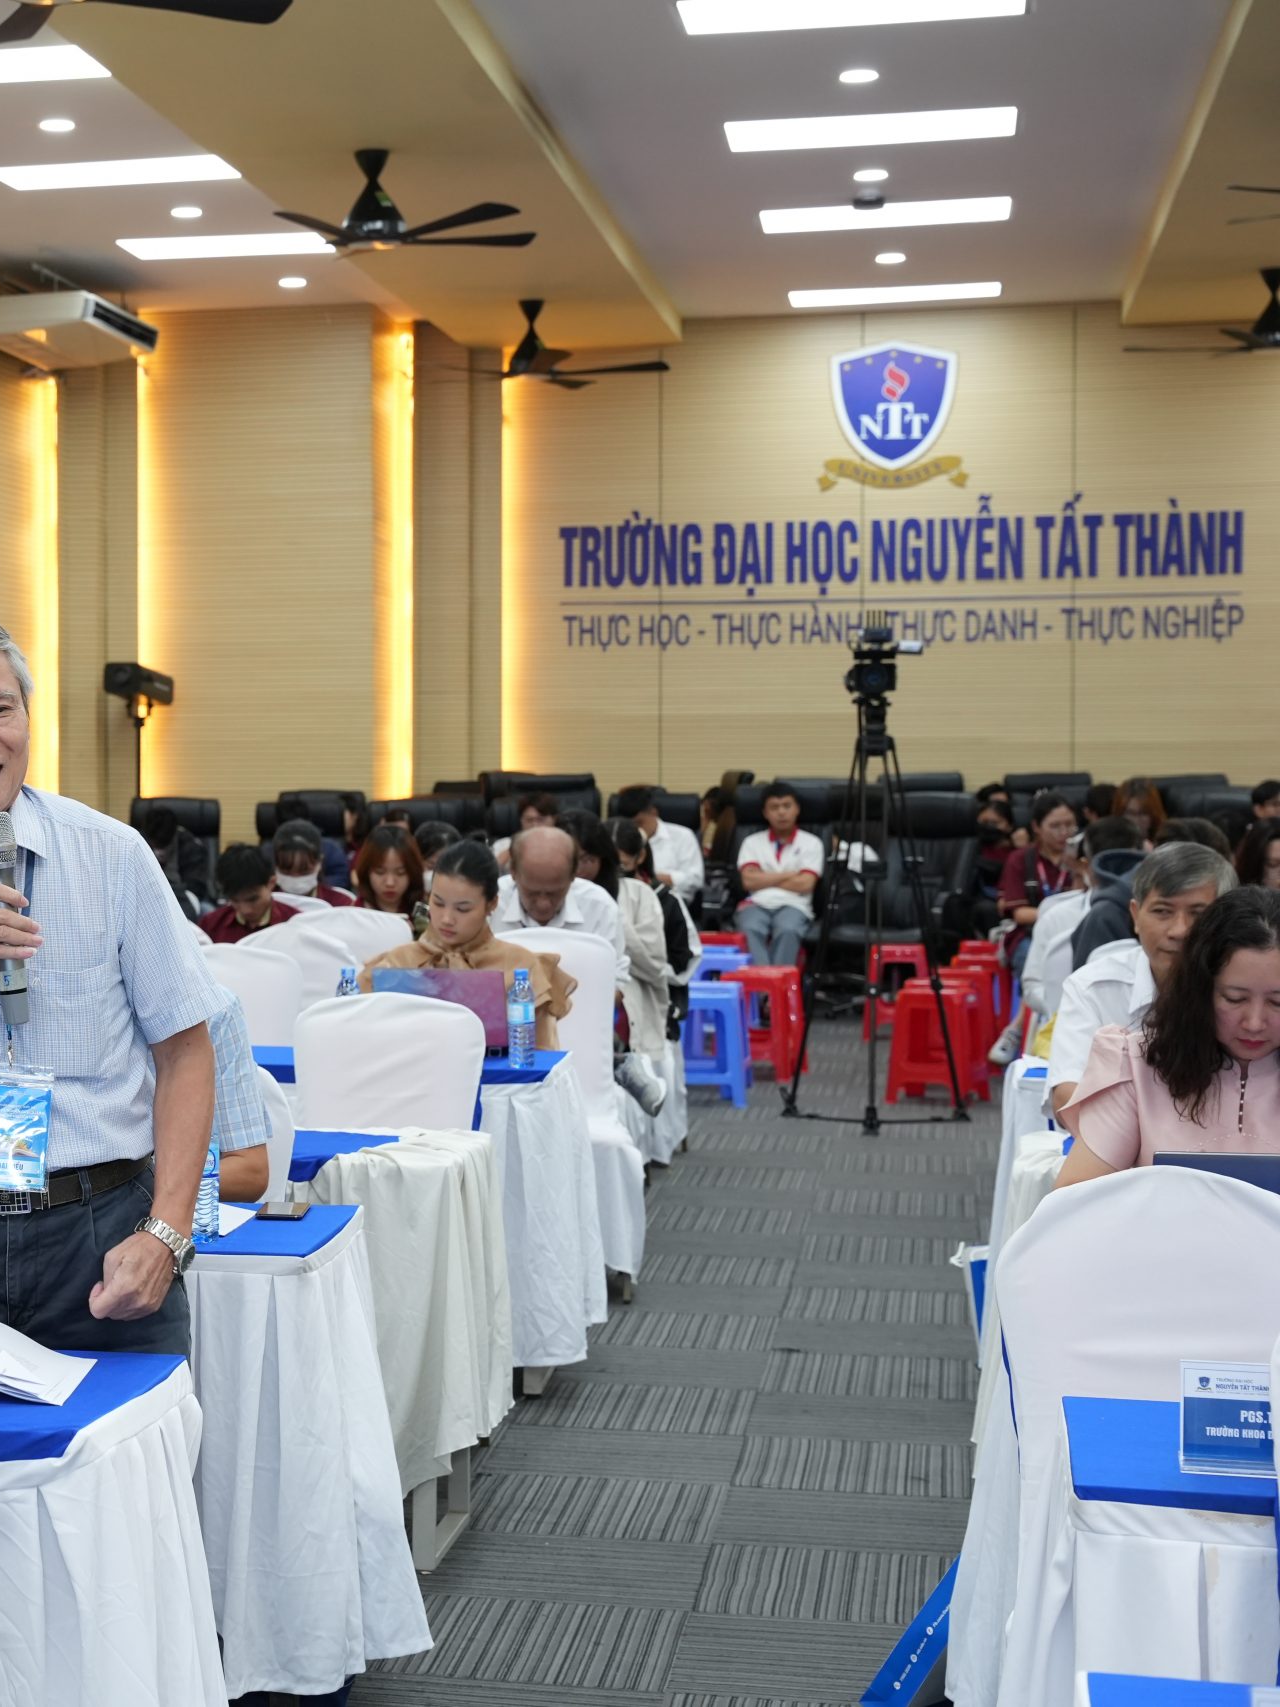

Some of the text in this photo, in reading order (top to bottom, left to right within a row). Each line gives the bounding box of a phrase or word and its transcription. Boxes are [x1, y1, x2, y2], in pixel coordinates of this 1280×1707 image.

[858, 401, 930, 440] NTT
[559, 491, 1244, 597] TRƯỜNG ĐẠI HỌC NGUYỄN TẤT THÀNH
[562, 614, 631, 652] THỰC
[638, 613, 691, 651] HỌC
[712, 611, 782, 650] THỰC
[789, 601, 863, 644] HÀNH
[886, 609, 956, 647] THỰC
[965, 608, 1038, 643] DANH
[1061, 606, 1135, 646] THỰC
[1142, 596, 1245, 643] NGHIỆP
[1242, 1429, 1265, 1439] KHOA
